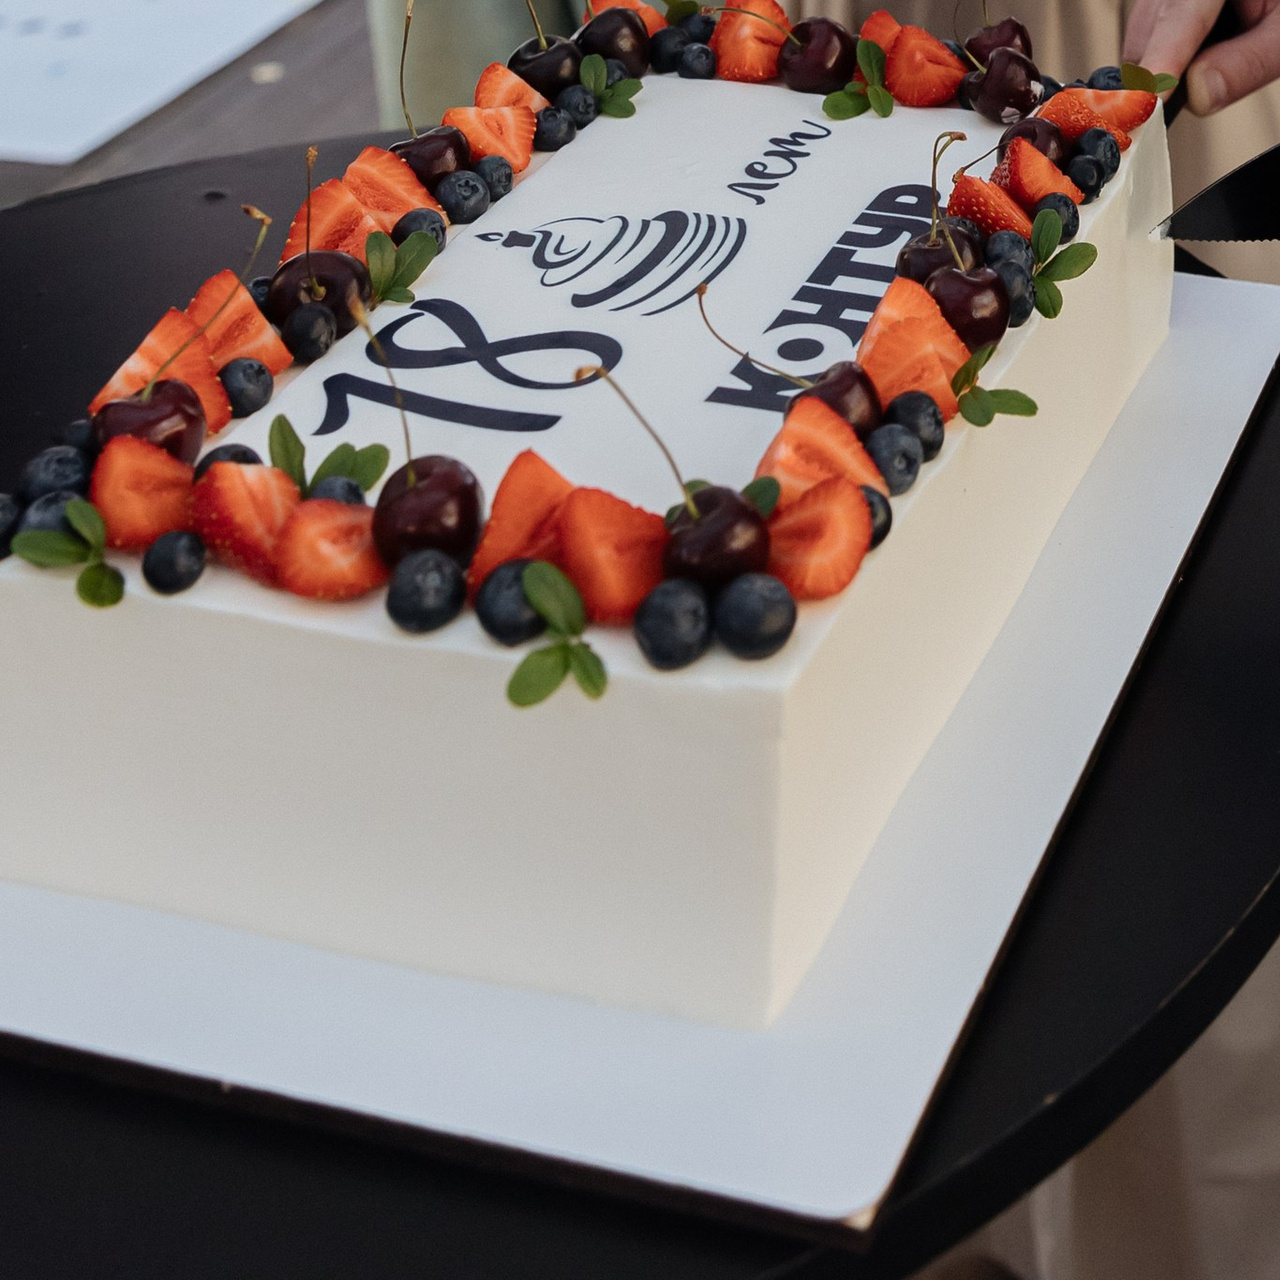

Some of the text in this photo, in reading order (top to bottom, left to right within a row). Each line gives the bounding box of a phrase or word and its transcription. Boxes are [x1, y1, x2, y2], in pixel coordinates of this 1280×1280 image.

[311, 119, 832, 436] 18 лет
[703, 183, 948, 412] КОНТУР
